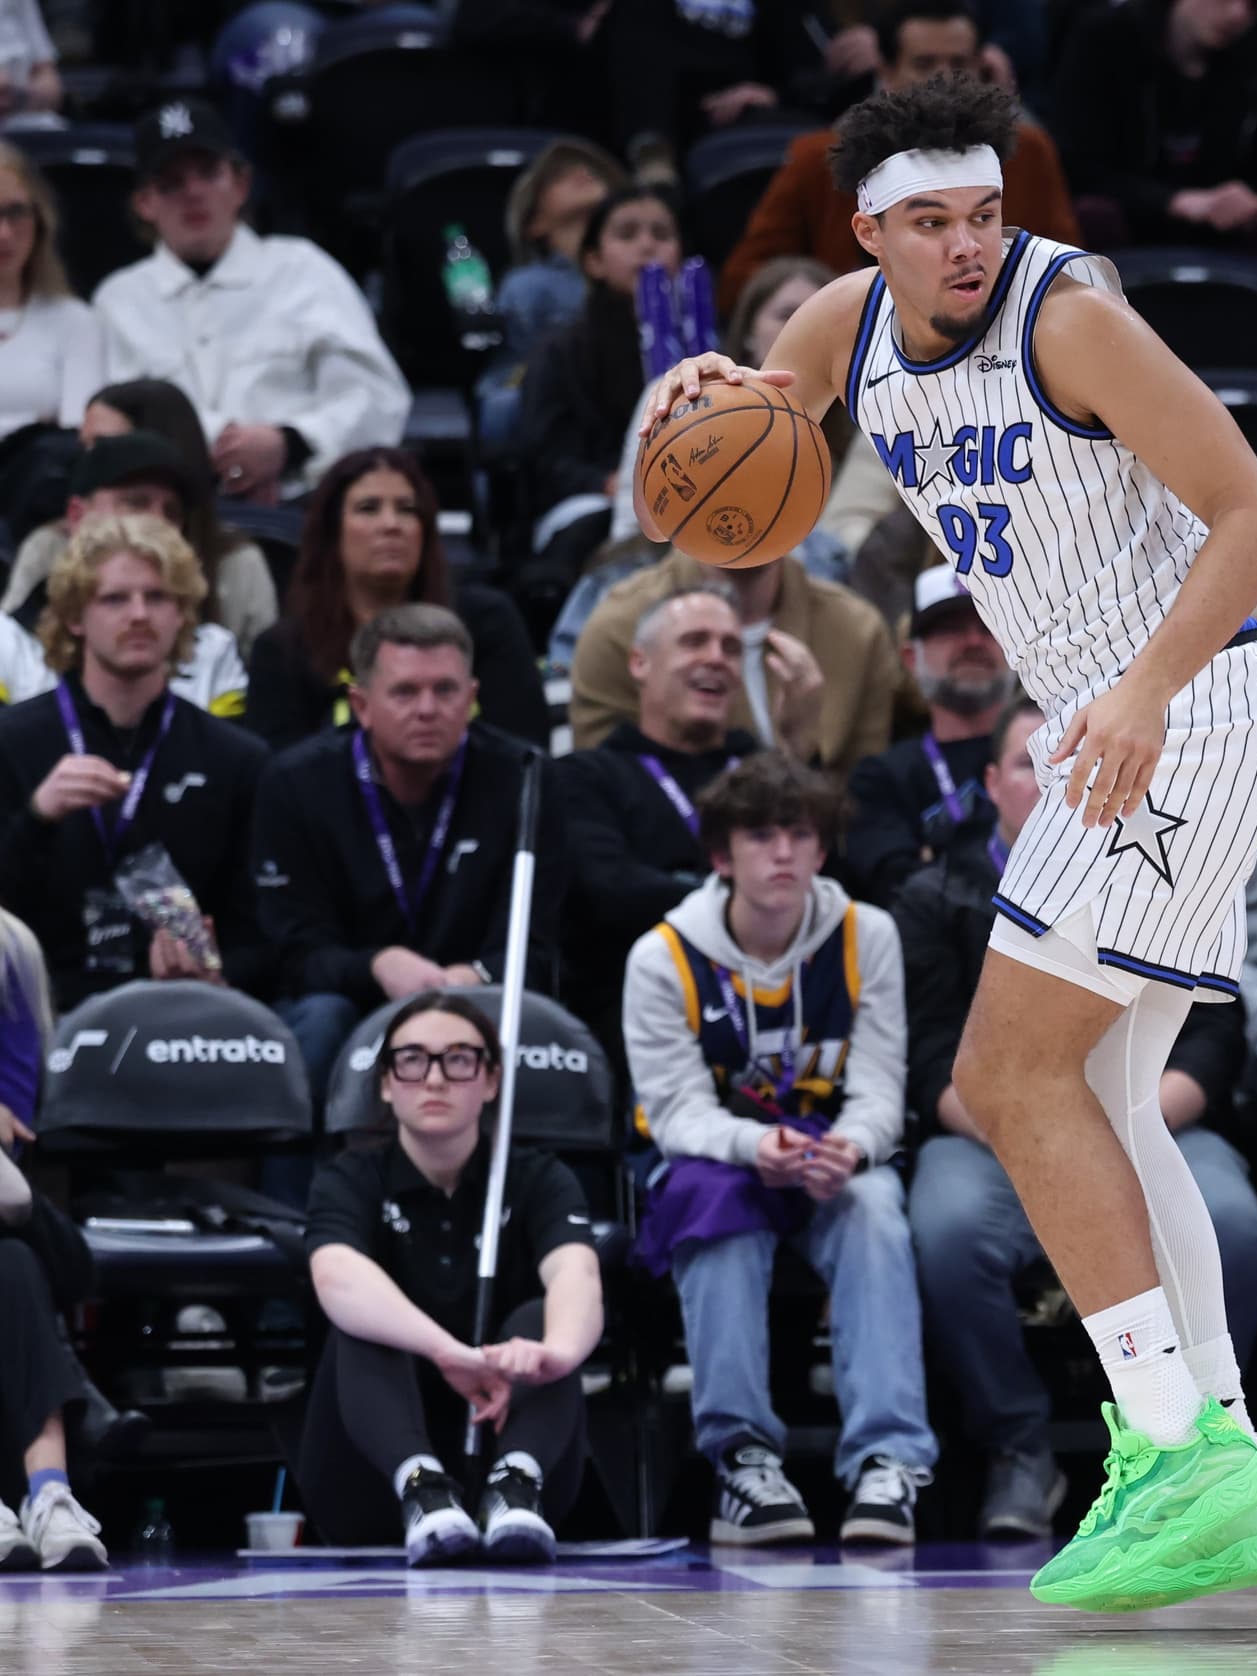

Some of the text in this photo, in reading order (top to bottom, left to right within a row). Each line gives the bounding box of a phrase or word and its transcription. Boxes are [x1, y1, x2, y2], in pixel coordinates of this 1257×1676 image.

[936, 502, 1014, 579] 93
[147, 1034, 286, 1065] entrata
[516, 1042, 588, 1073] rata
